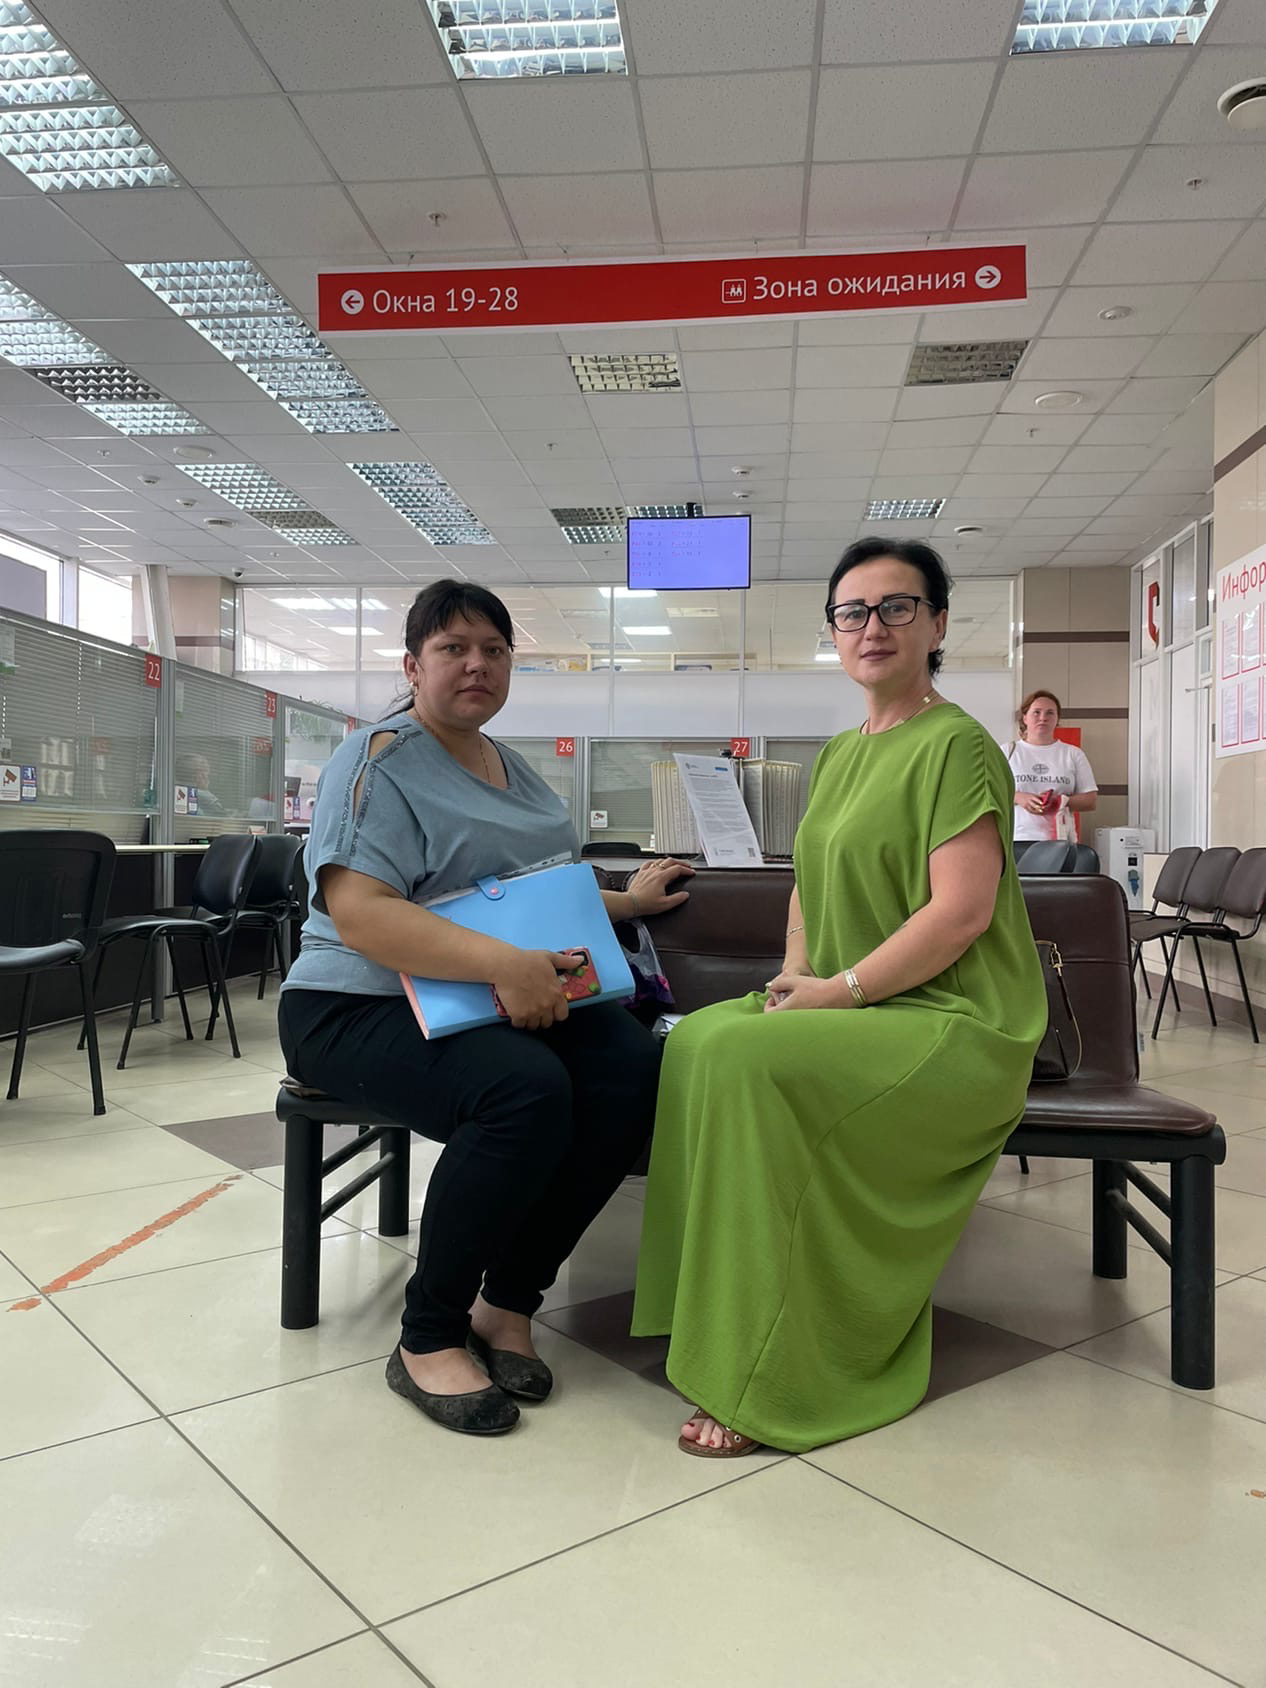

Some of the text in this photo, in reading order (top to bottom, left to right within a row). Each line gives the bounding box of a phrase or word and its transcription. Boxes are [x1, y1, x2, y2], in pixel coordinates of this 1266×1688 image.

[753, 271, 967, 300] Зона ожидания
[374, 287, 518, 313] Окна 19-28
[148, 661, 160, 681] 22
[559, 741, 573, 753] 26
[734, 741, 748, 753] 27
[1015, 774, 1039, 783] TONE
